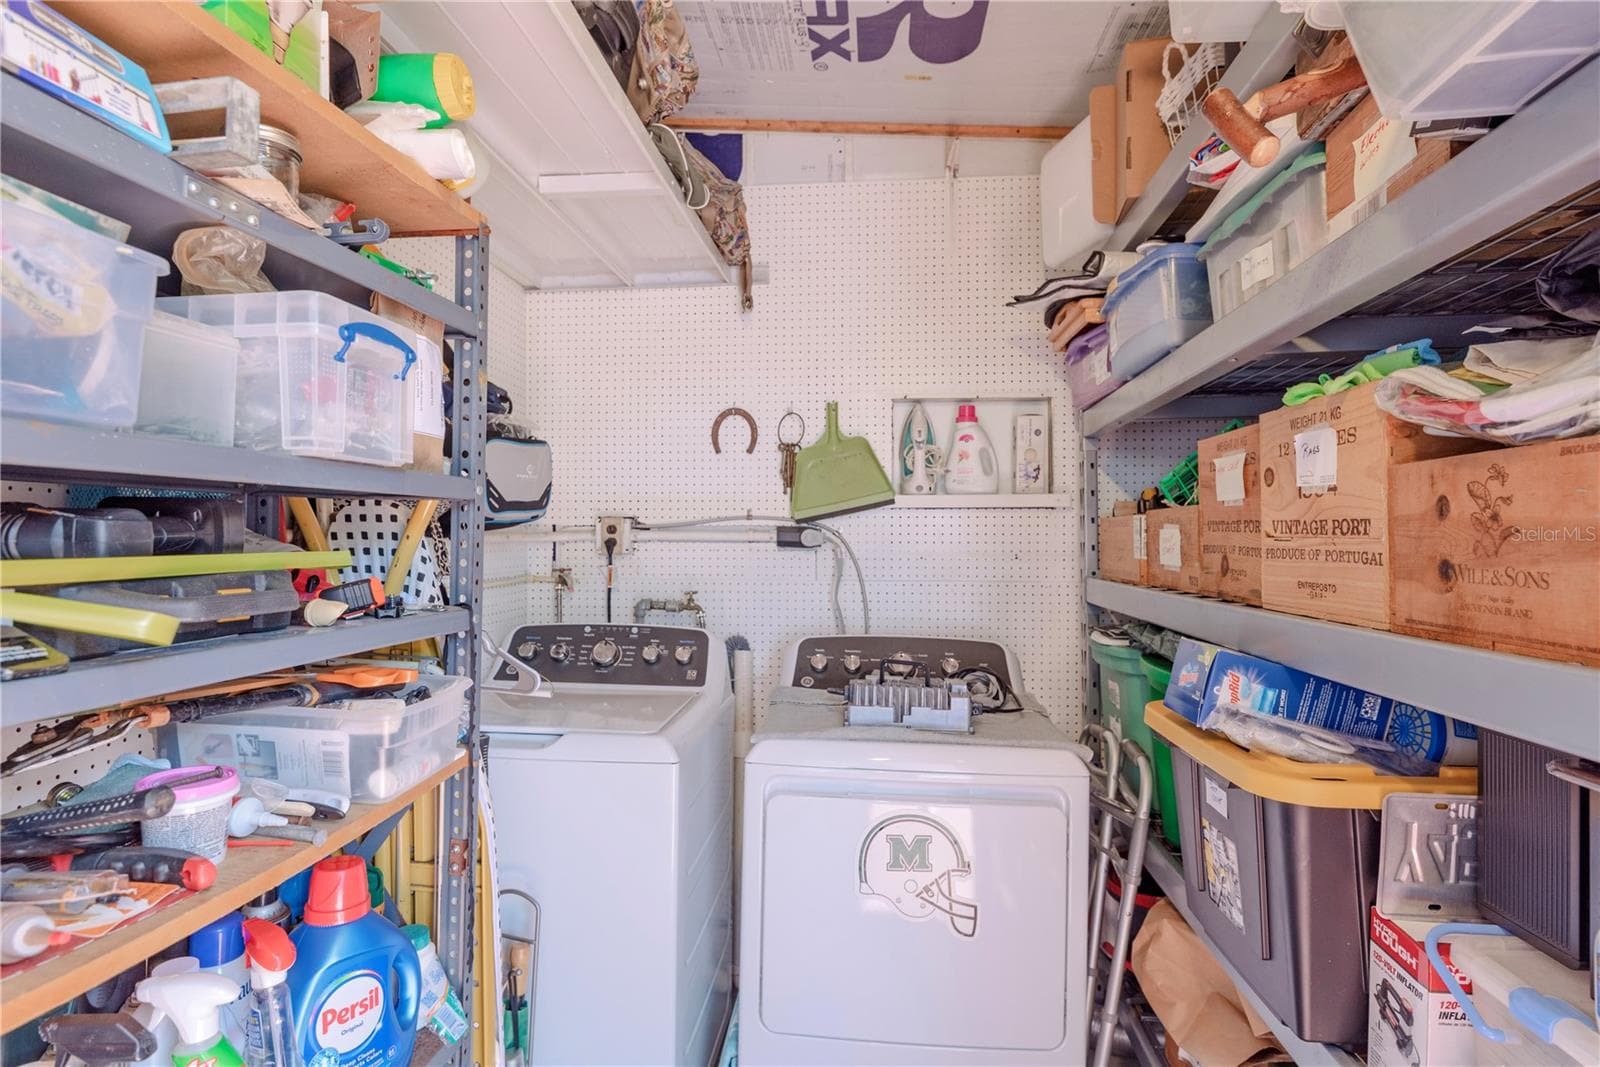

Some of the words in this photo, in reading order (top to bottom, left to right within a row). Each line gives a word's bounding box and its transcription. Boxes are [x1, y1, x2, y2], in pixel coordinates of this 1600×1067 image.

[1288, 412, 1317, 431] WEIGHT
[1319, 411, 1328, 422] 21
[1330, 406, 1342, 421] KG
[1278, 442, 1290, 457] 12
[1207, 520, 1241, 533] VINTAGE
[1243, 519, 1262, 534] POR
[1272, 519, 1329, 536] VINTAGE
[1331, 518, 1372, 537] PORT
[1238, 545, 1262, 559] PORTU
[1265, 547, 1306, 561] PRODUCE
[1308, 548, 1321, 561] OF
[1297, 580, 1337, 593] ENTREPOSTO
[886, 834, 932, 872] M
[1373, 916, 1398, 939] HYPER
[1374, 923, 1418, 970] TOUGH
[1396, 970, 1424, 1001] INFLATOR
[321, 986, 380, 1035] Persil
[1440, 1001, 1461, 1010] 120-
[1438, 1011, 1467, 1021] INFLA
